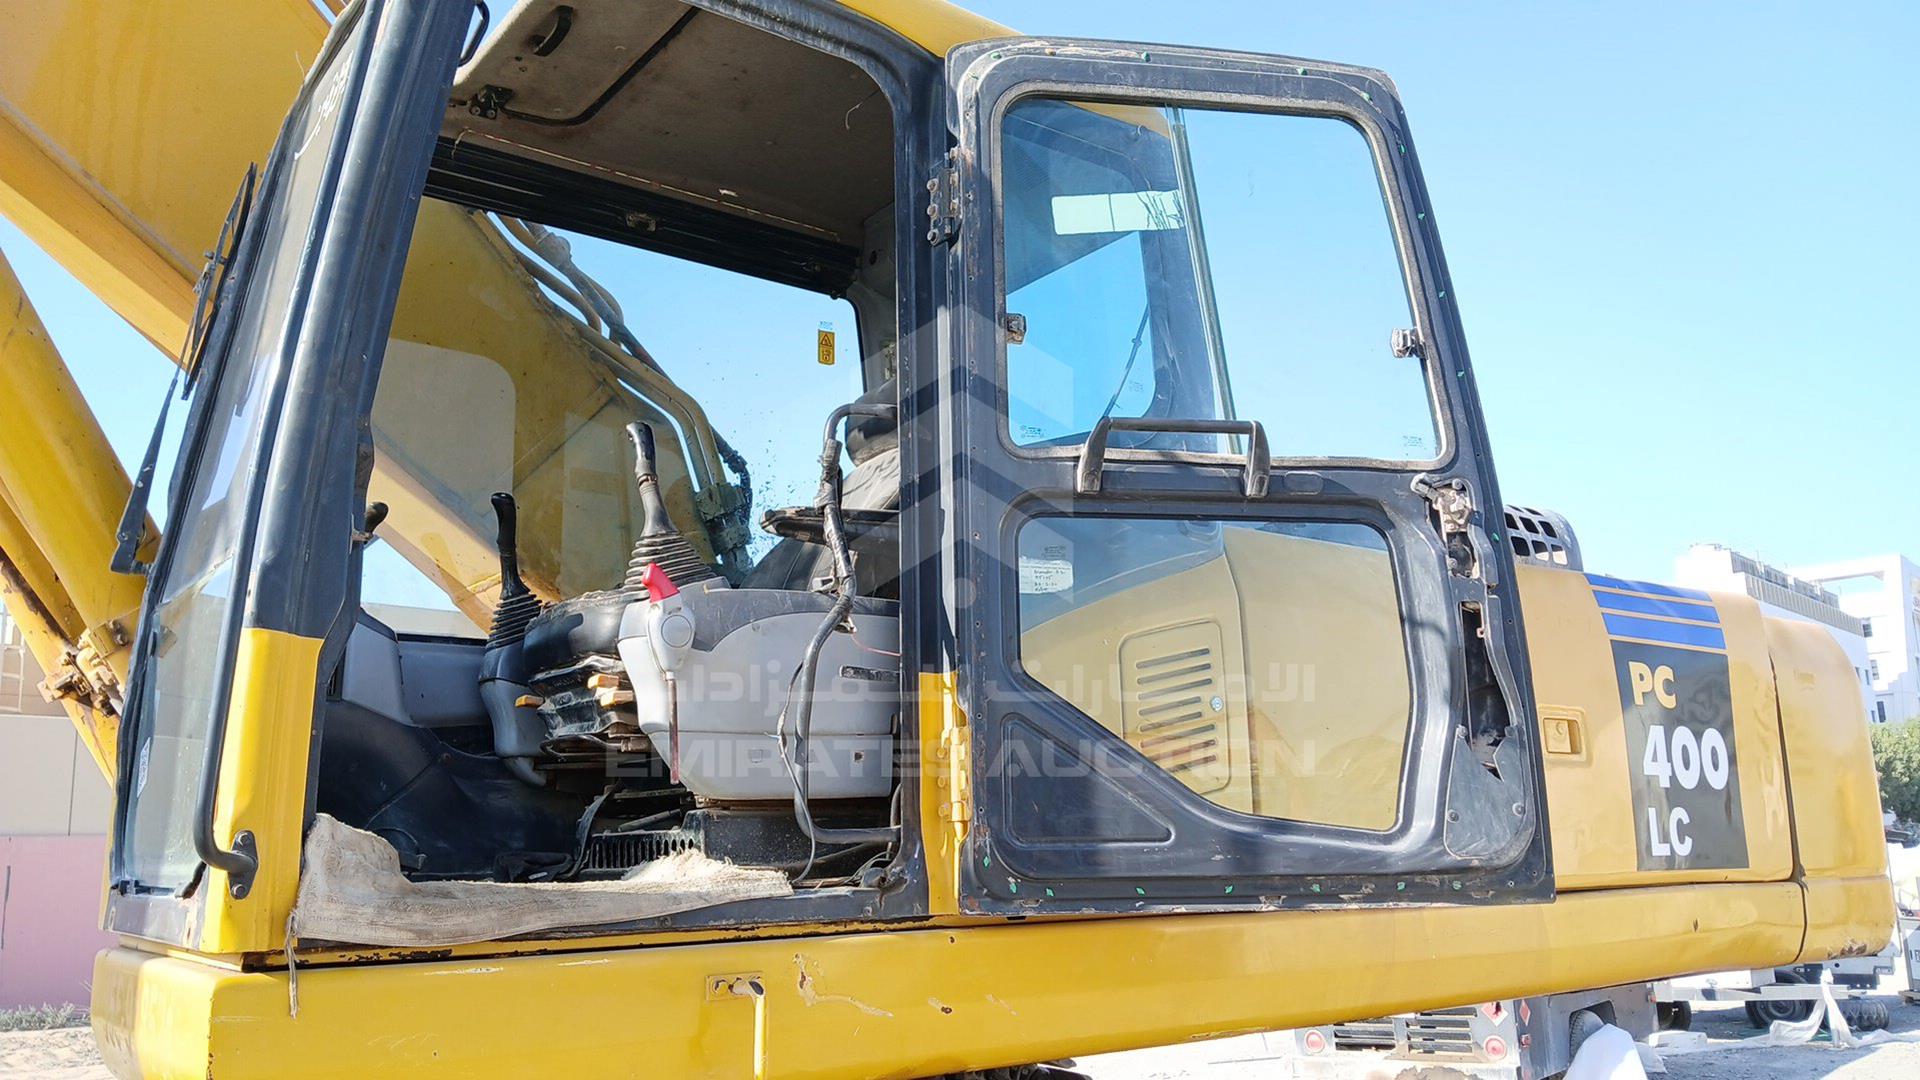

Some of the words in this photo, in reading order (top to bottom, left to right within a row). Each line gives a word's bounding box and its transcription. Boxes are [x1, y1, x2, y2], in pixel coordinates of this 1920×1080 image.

[1628, 661, 1677, 709] PC
[1643, 725, 1729, 790] 400
[1648, 806, 1692, 856] LC
